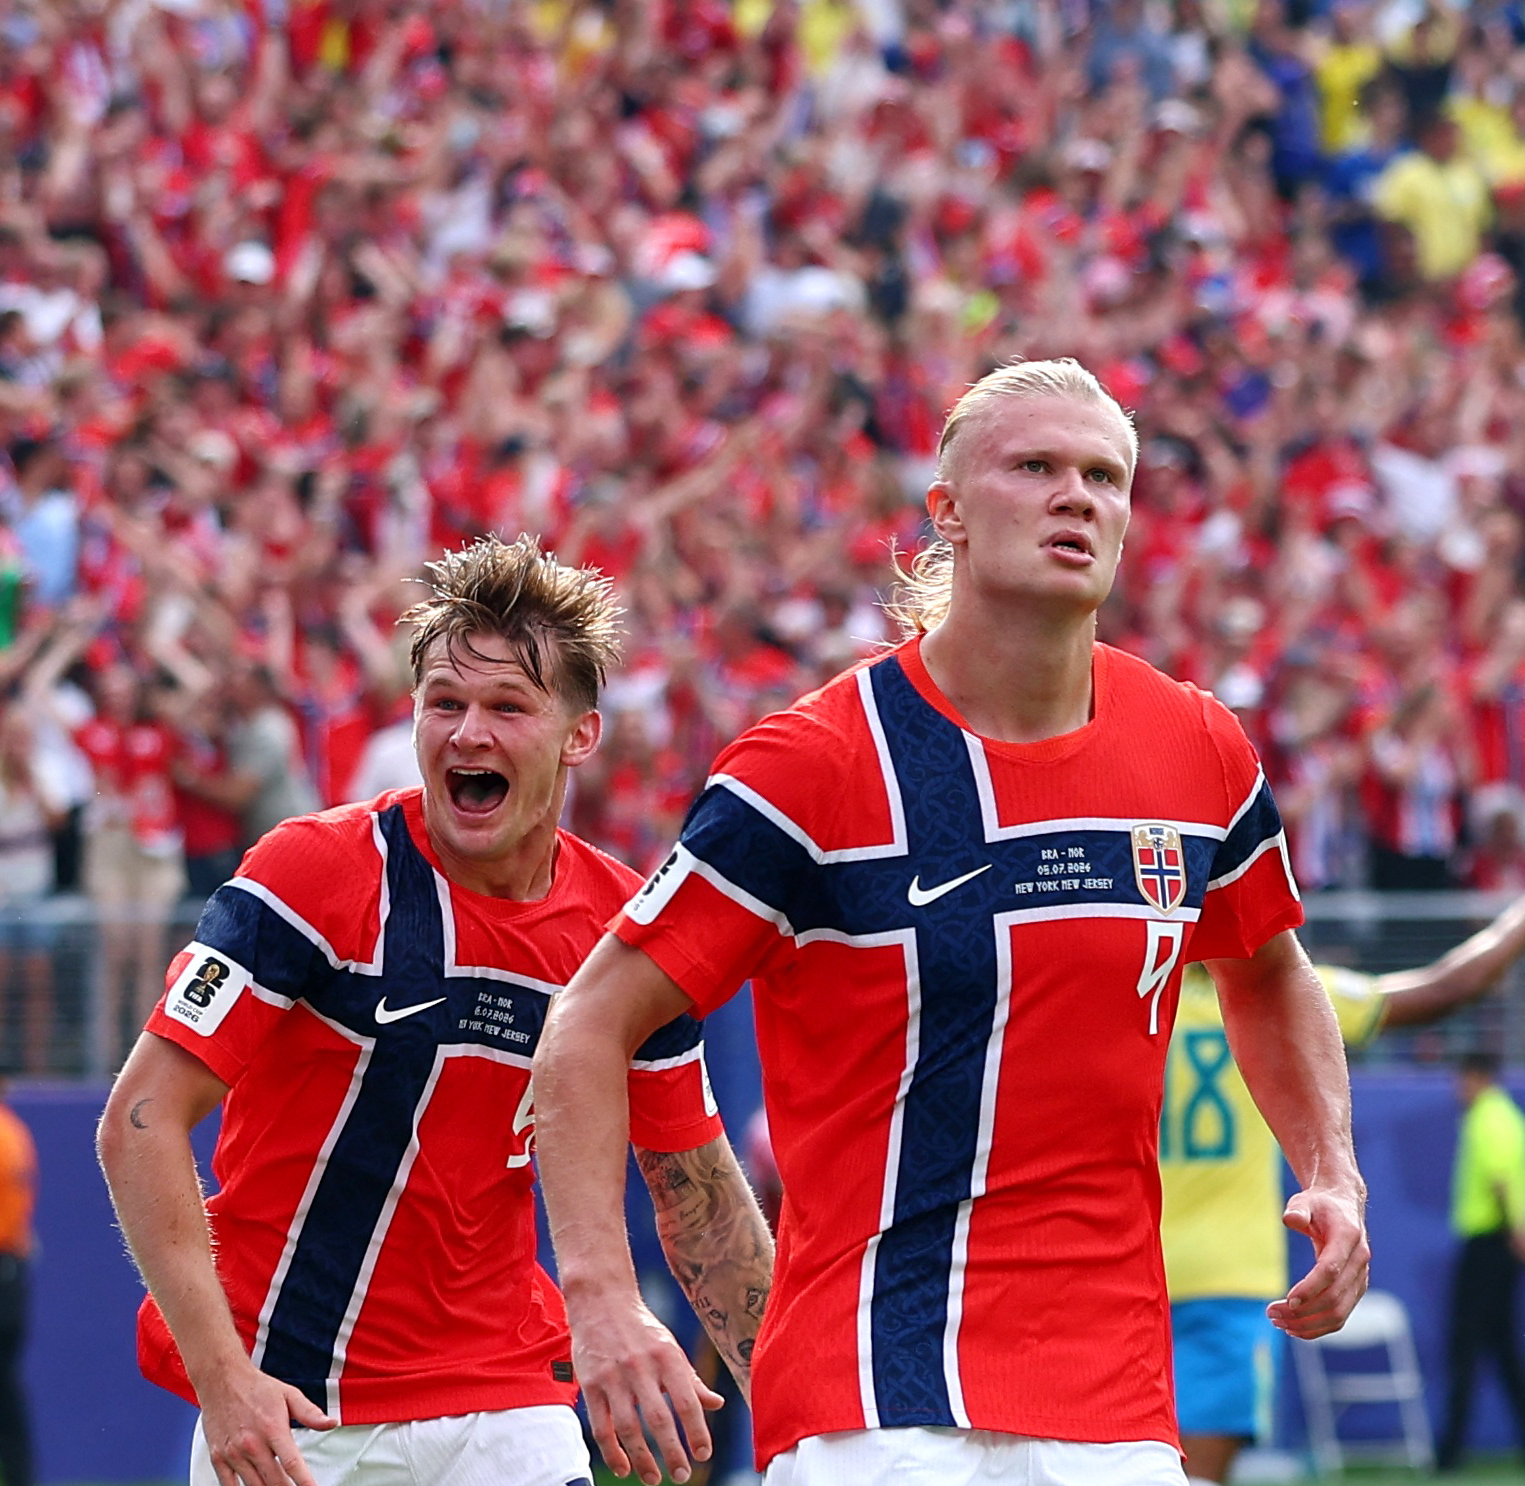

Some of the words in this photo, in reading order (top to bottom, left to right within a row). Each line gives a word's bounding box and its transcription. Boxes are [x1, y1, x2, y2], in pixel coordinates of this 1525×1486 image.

[1041, 849, 1059, 860] BRA
[1068, 847, 1085, 858] NOR
[1037, 862, 1091, 875] 05.07.2026
[1015, 882, 1034, 894] NEW
[1036, 880, 1060, 892] YORK
[1061, 879, 1080, 890] NEW
[1082, 878, 1114, 889] JERSEY
[1136, 920, 1184, 1035] 9
